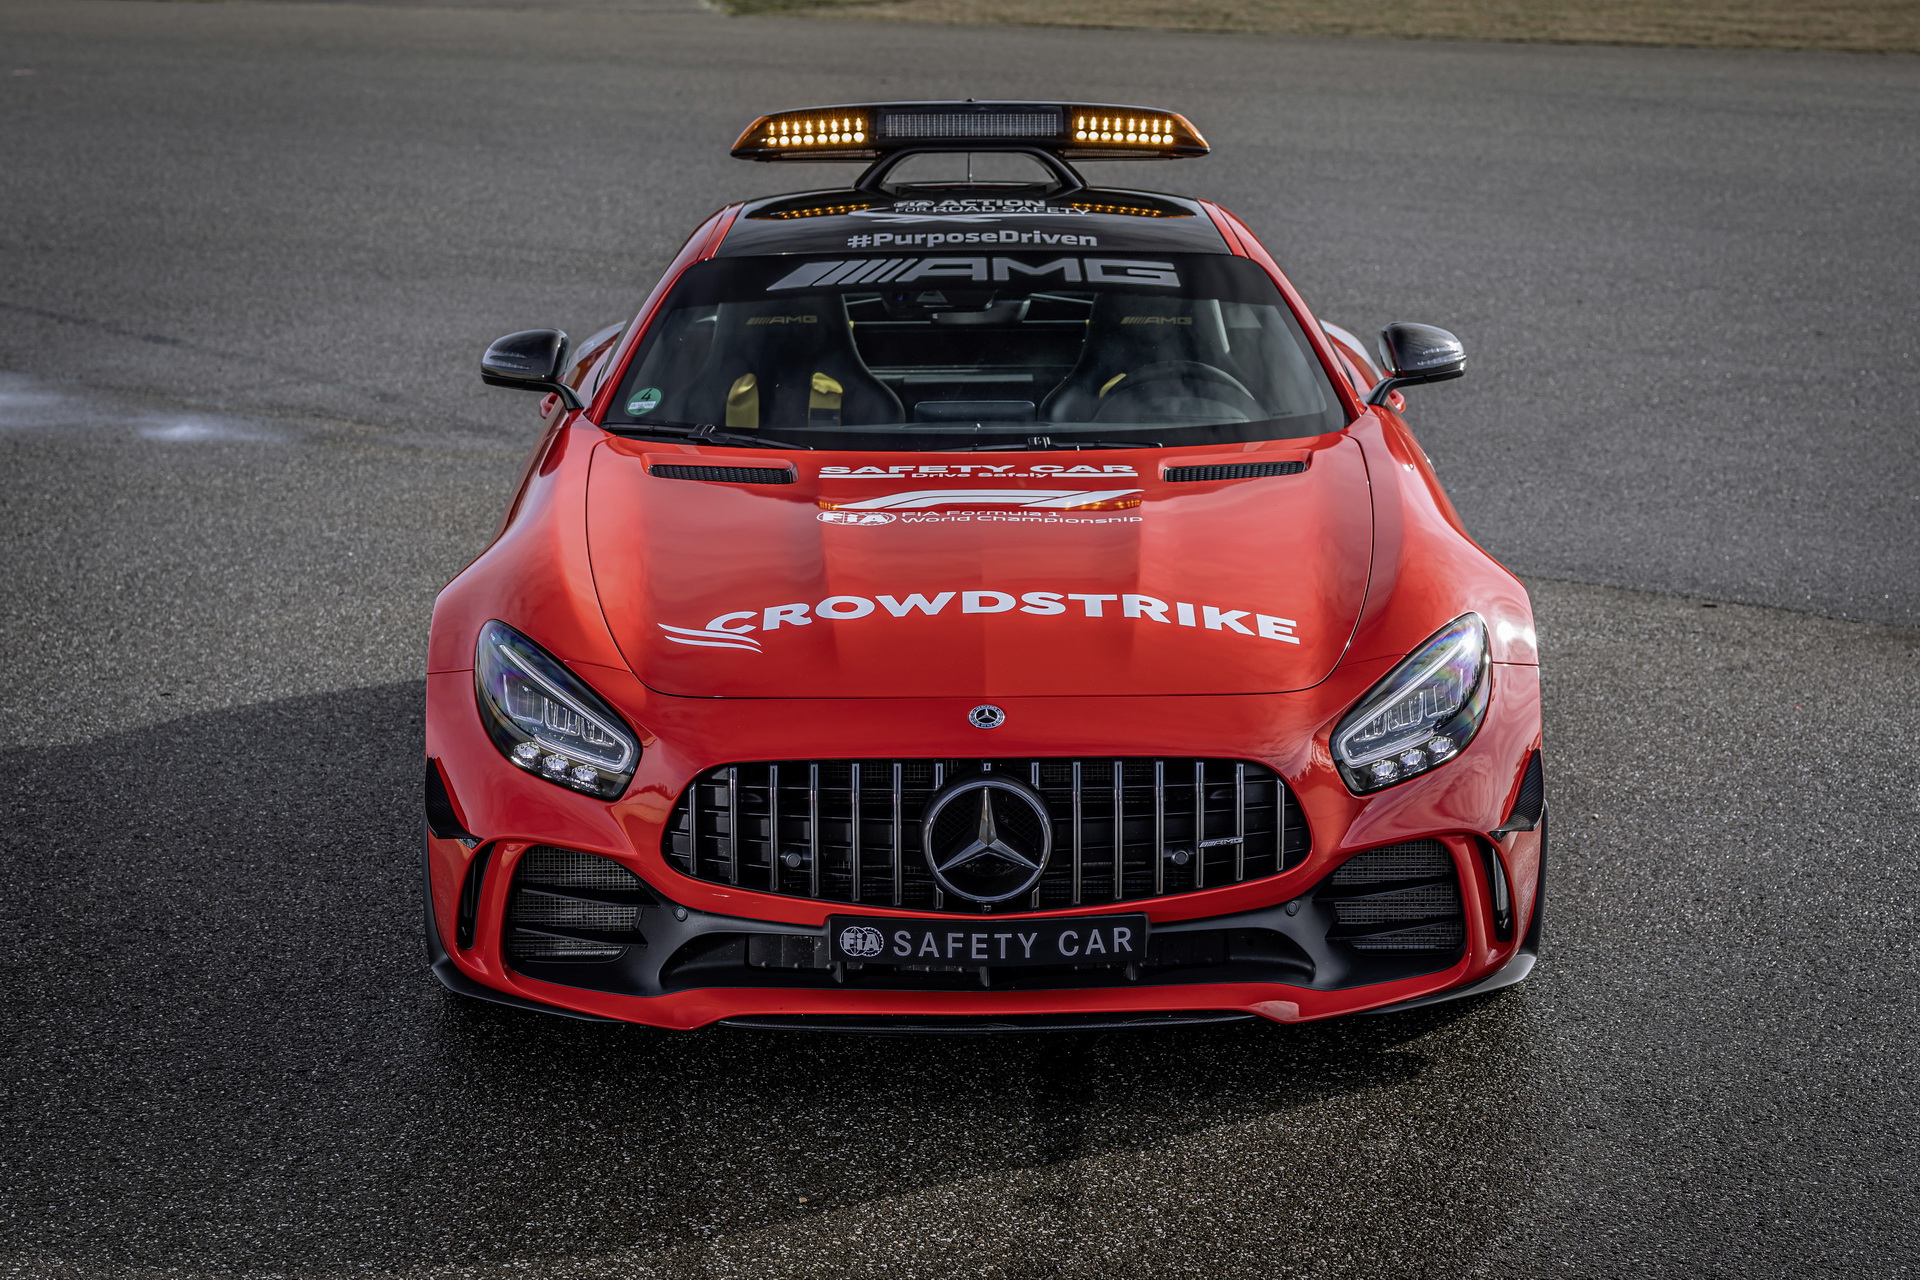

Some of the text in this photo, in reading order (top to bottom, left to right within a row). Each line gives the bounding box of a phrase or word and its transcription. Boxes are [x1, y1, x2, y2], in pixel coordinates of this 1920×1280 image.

[939, 199, 1046, 208] ACTION
[1002, 206, 1091, 215] SAFETY
[847, 230, 1098, 248] #PurposeDriven
[895, 257, 1181, 288] AMG
[769, 315, 818, 324] AMG
[1144, 316, 1193, 325] AMG
[641, 389, 653, 402] 4
[819, 464, 1137, 474] SAFETY CAR
[901, 515, 1144, 524] World Championship
[705, 591, 1300, 645] CROWDSTRIKE
[893, 929, 1038, 960] SAFETY
[1058, 927, 1133, 957] CAR
